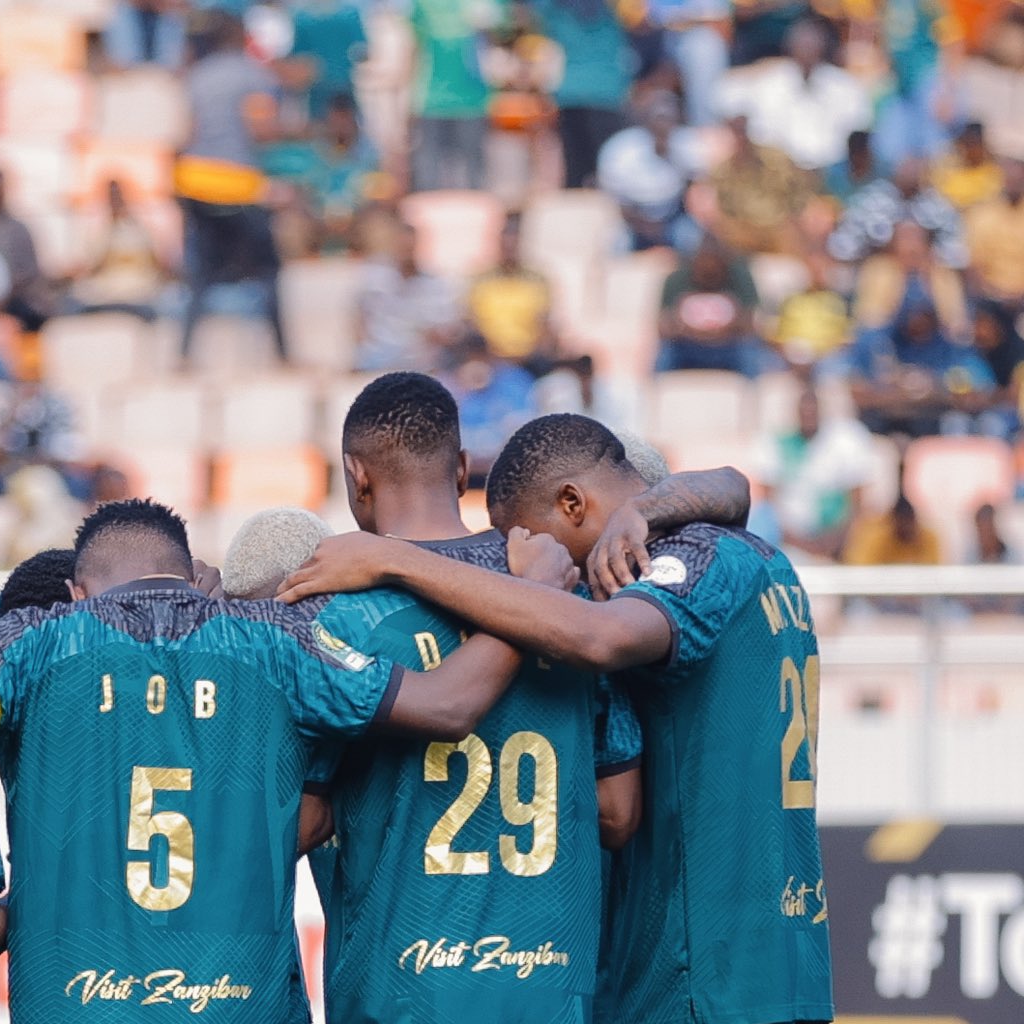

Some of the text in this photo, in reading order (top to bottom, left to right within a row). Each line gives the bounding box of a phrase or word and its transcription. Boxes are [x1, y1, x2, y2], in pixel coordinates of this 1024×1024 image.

[125, 766, 195, 912] 5
[423, 731, 558, 877] 29
[65, 969, 252, 1013] Visit Zanzibar
[399, 937, 472, 974] Visit
